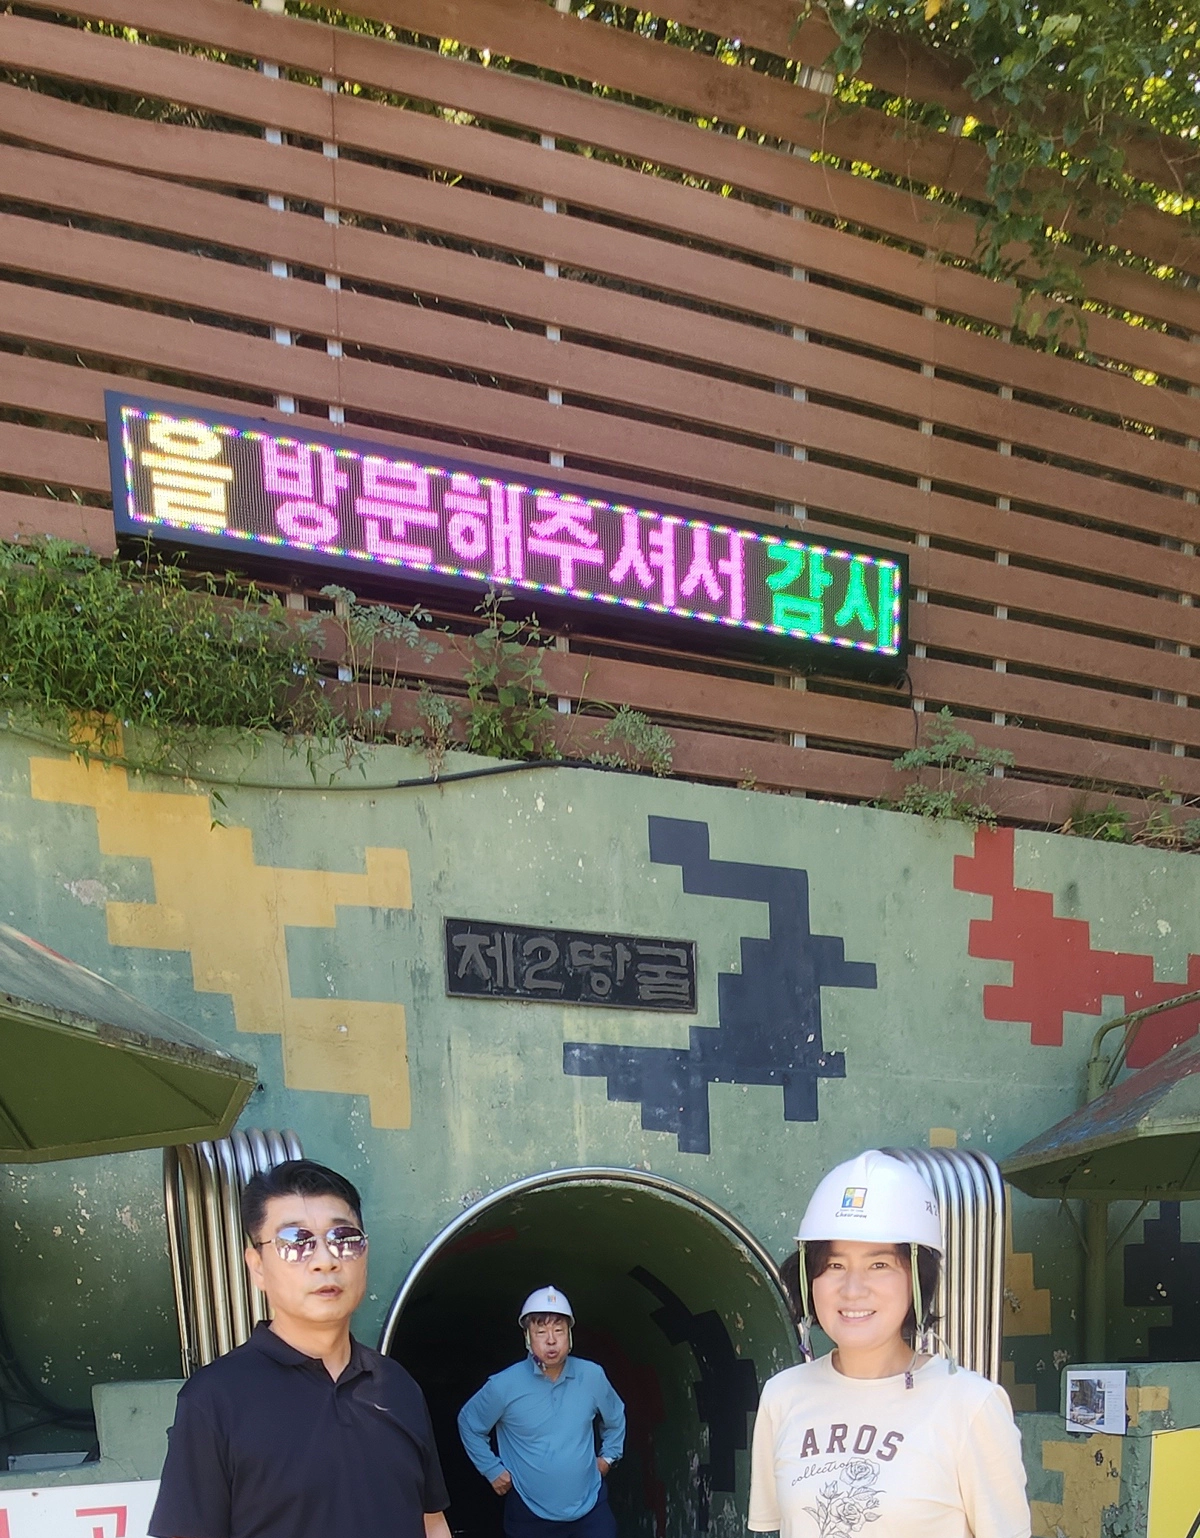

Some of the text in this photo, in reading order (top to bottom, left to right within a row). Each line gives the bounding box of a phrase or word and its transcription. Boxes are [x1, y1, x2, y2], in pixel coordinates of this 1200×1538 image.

[139, 419, 234, 528] 을
[261, 436, 746, 622] 방문해주셔서
[452, 932, 690, 1001] 제2땅굴
[800, 1423, 905, 1462] AROS
